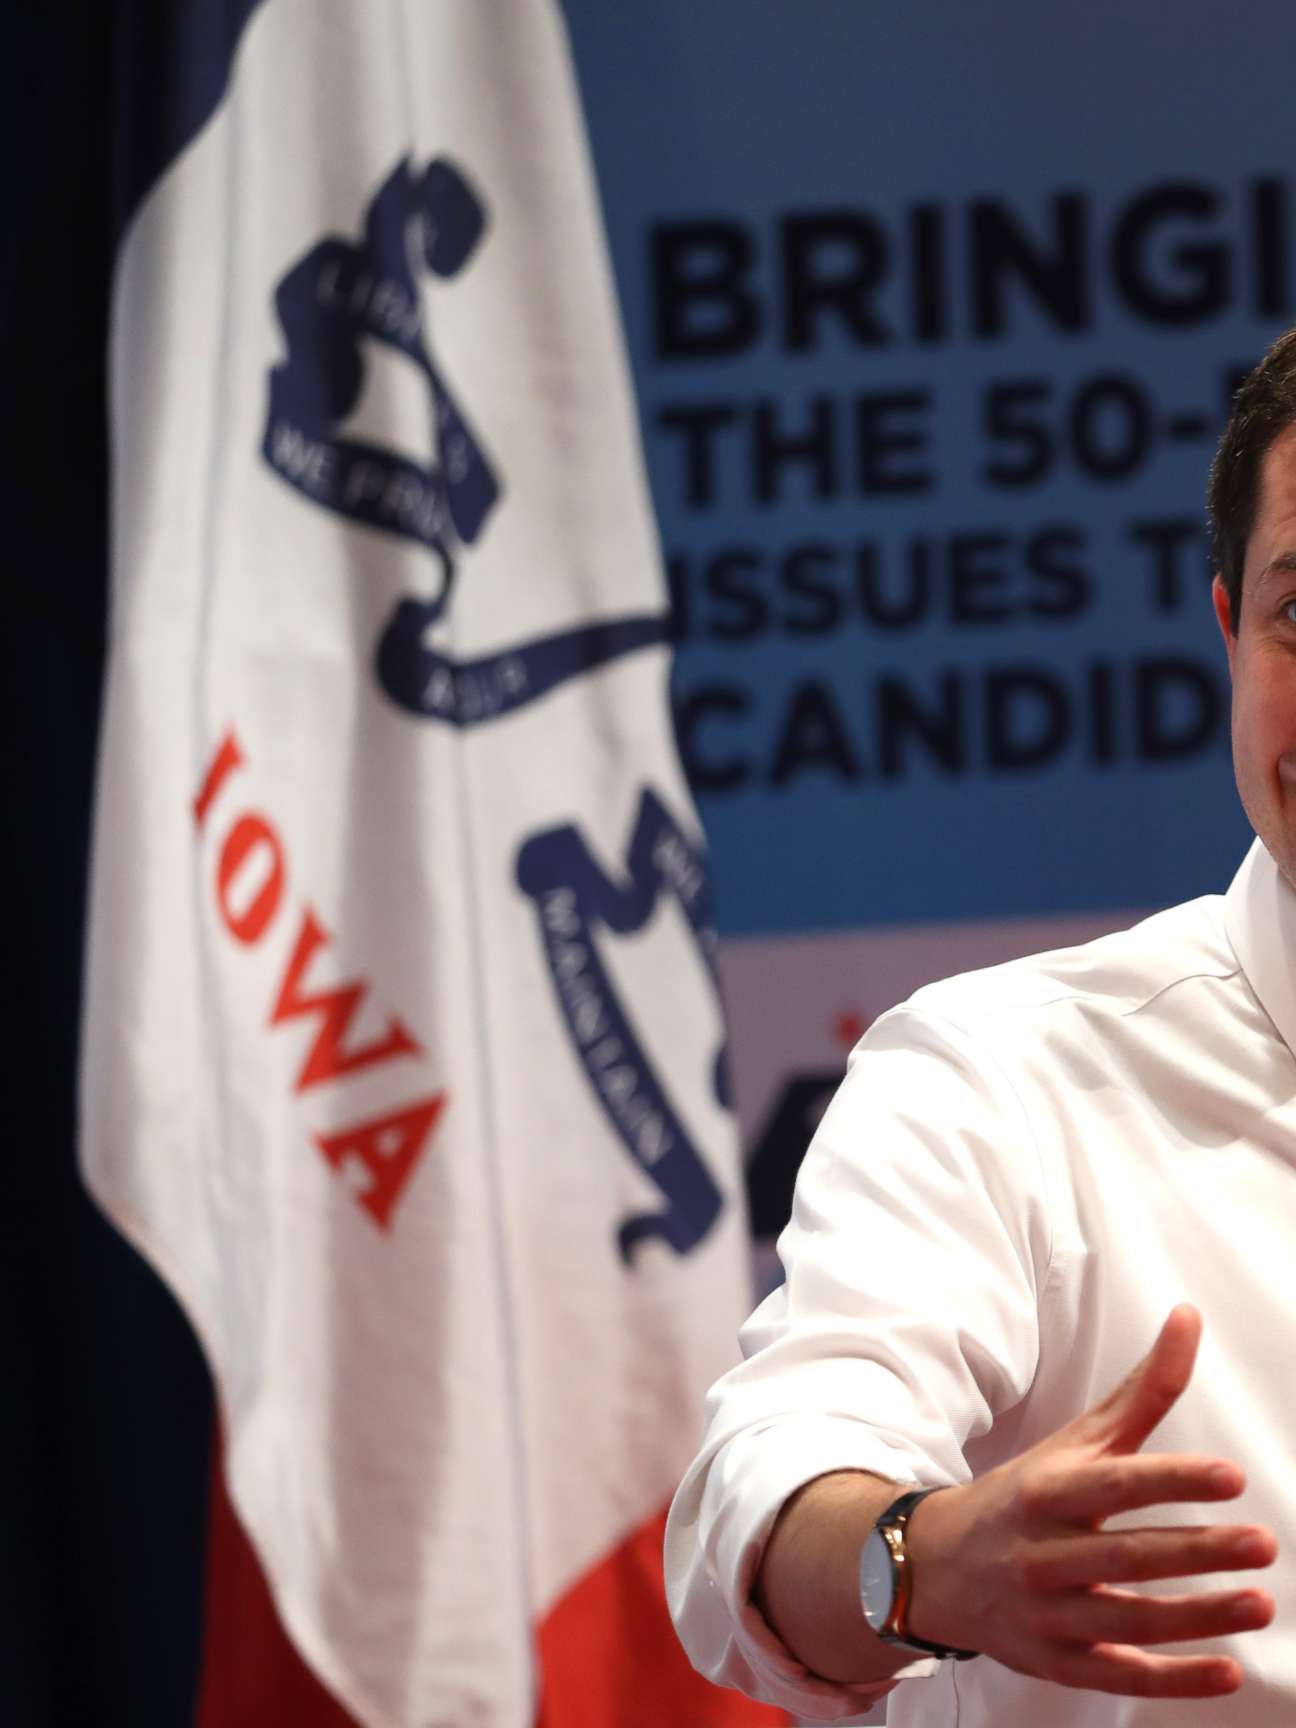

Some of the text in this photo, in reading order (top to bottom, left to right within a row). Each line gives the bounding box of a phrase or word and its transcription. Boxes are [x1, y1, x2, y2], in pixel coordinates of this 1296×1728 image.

[657, 362, 1250, 510] THE 50-
[667, 513, 1208, 645] ISSUES T
[674, 652, 1226, 795] CANDID
[191, 726, 453, 1239] IOWA
